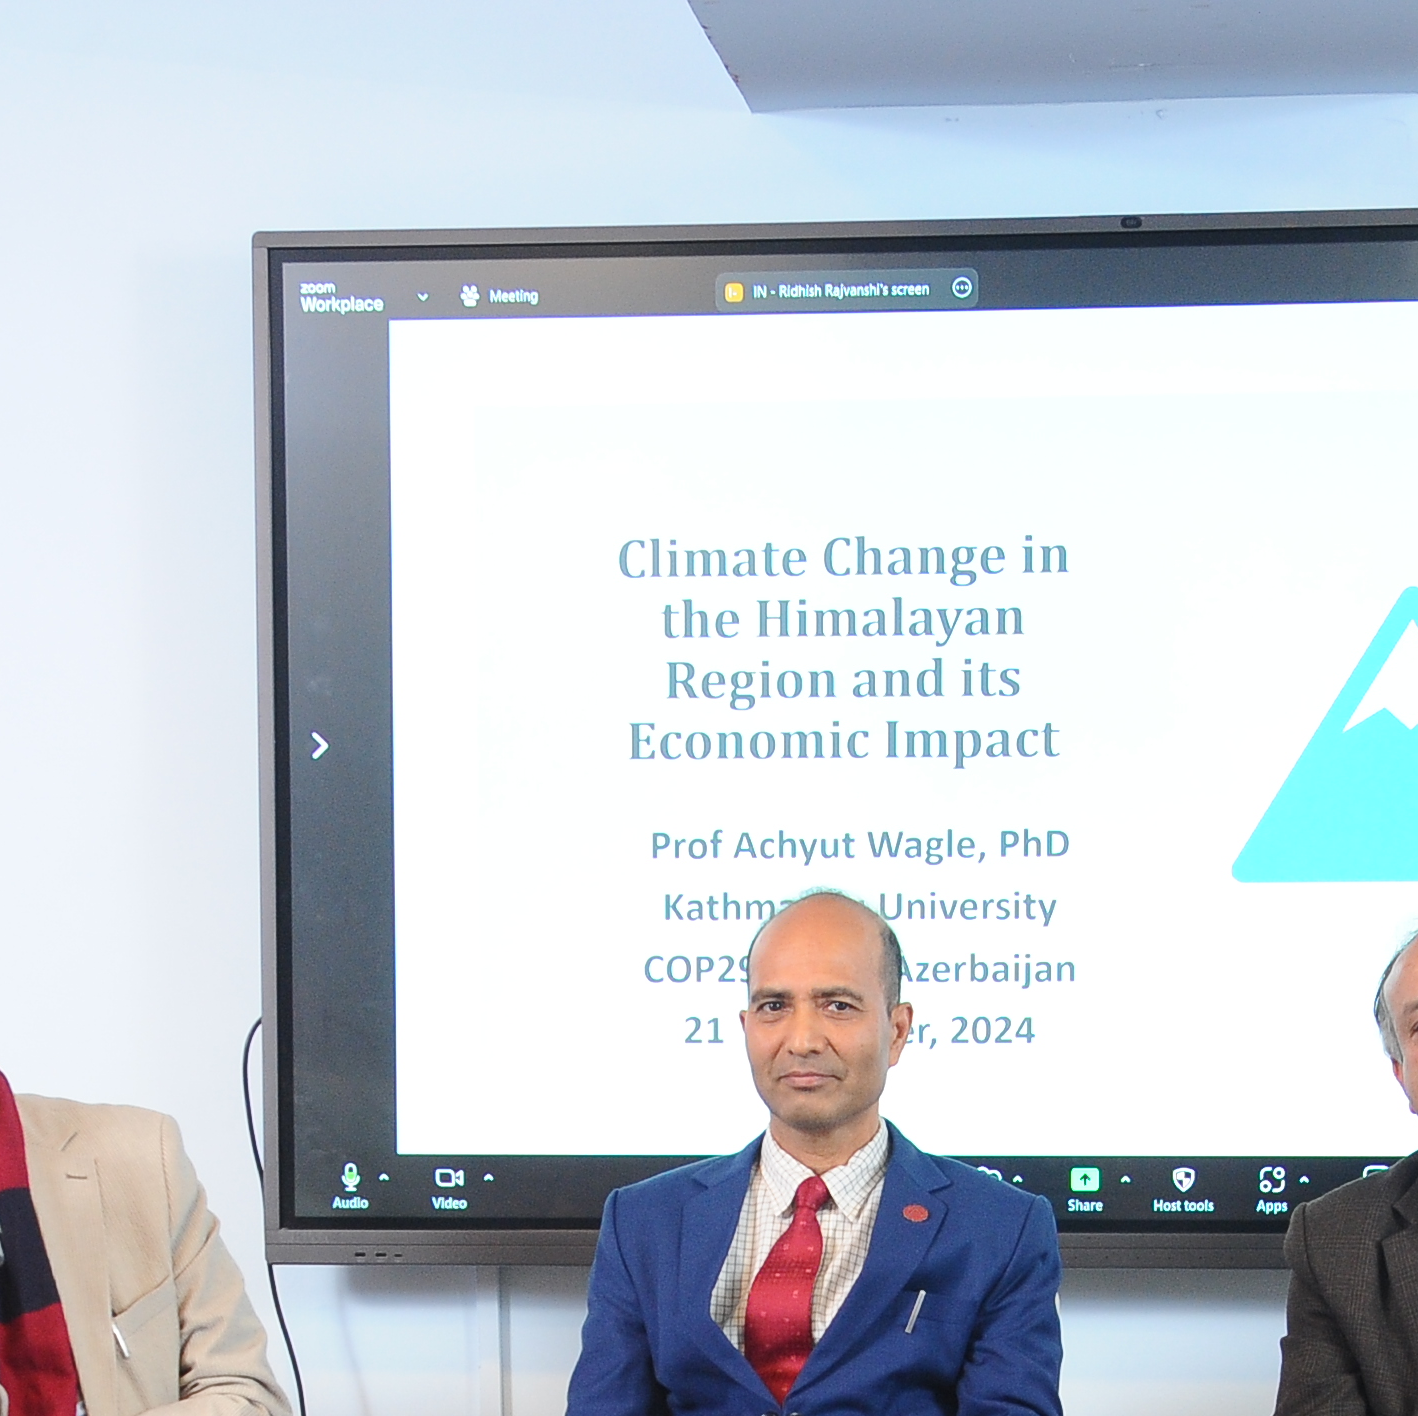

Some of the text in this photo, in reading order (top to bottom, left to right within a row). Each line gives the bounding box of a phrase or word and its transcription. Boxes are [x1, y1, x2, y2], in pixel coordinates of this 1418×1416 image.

[300, 282, 337, 295] zoom
[489, 289, 540, 306] Meeting
[753, 284, 767, 299] IN
[779, 284, 822, 299] Ridhish
[825, 282, 889, 301] Rajvanshi's
[891, 283, 931, 297] screen
[300, 295, 385, 315] Workplace
[617, 534, 1070, 587] Climate Change in
[661, 596, 1025, 648] the Himalayan
[666, 657, 1022, 711] Region and its
[628, 719, 1061, 769] Economic Impact
[651, 829, 1070, 866] Prof Achyut Wagle, PhD
[879, 891, 1058, 927] University
[684, 1016, 724, 1044] 21
[950, 1016, 1036, 1045] 2024
[332, 1195, 369, 1210] Audio
[431, 1195, 468, 1210] Video
[1067, 1198, 1104, 1213] Share
[1153, 1198, 1215, 1213] Host tools
[1256, 1198, 1289, 1215] Apps
